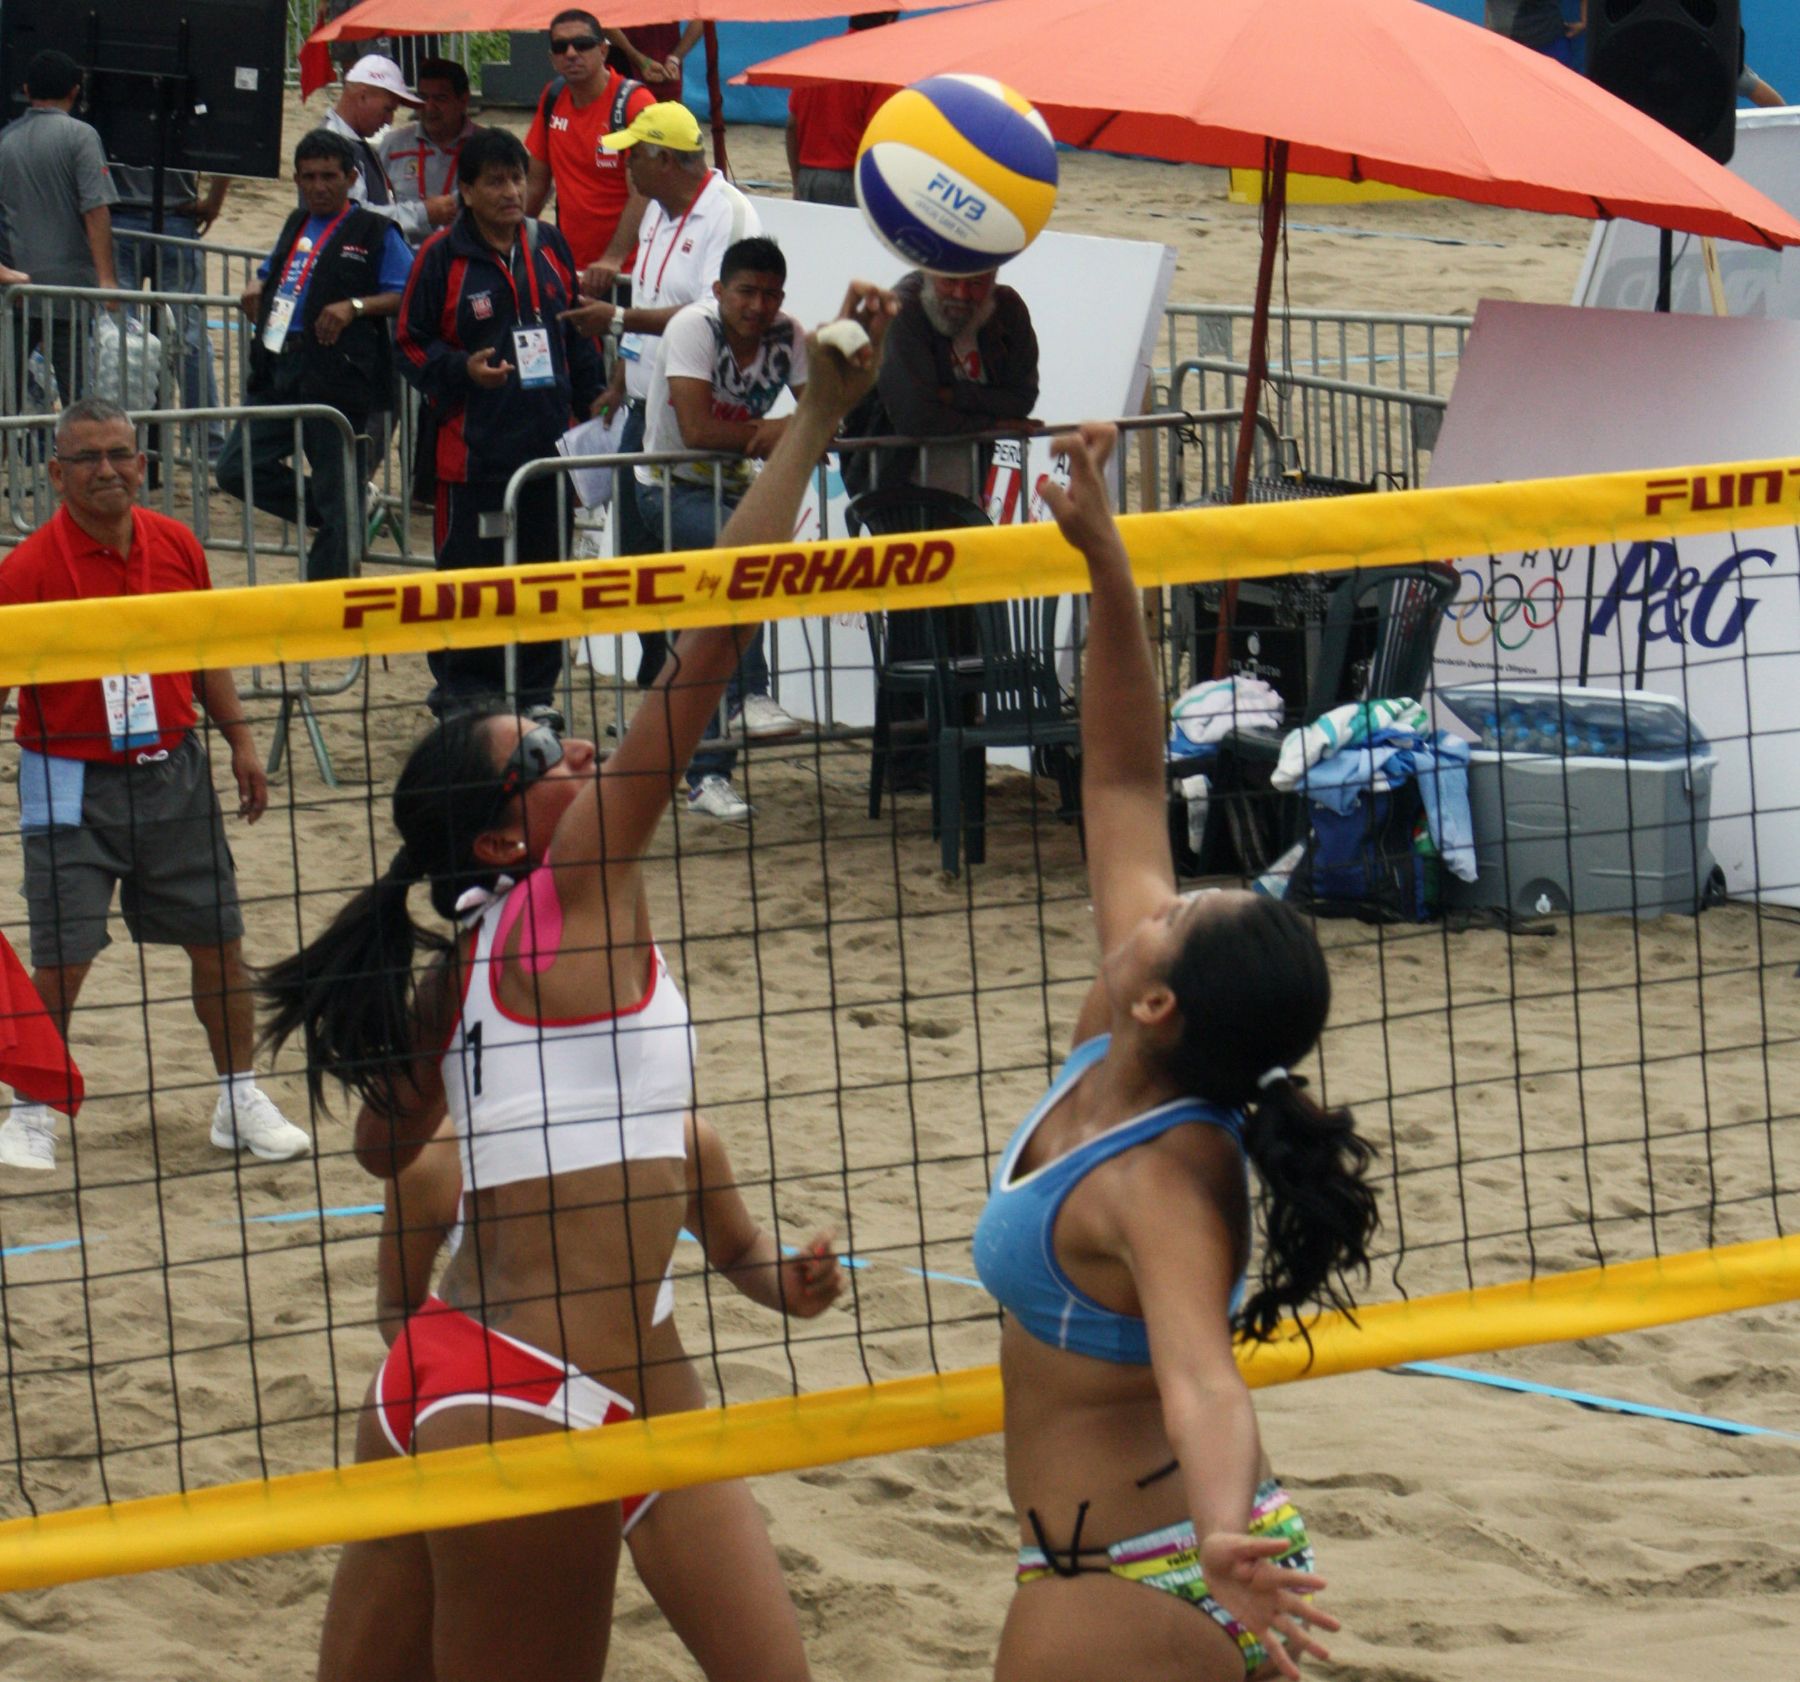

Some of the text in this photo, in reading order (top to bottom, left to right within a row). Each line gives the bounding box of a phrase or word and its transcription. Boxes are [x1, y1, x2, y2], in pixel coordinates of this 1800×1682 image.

[928, 172, 986, 220] FIVB
[343, 541, 955, 629] FUNTEC by ERHARD
[1590, 540, 1777, 648] P&G
[466, 1020, 482, 1097] 1
